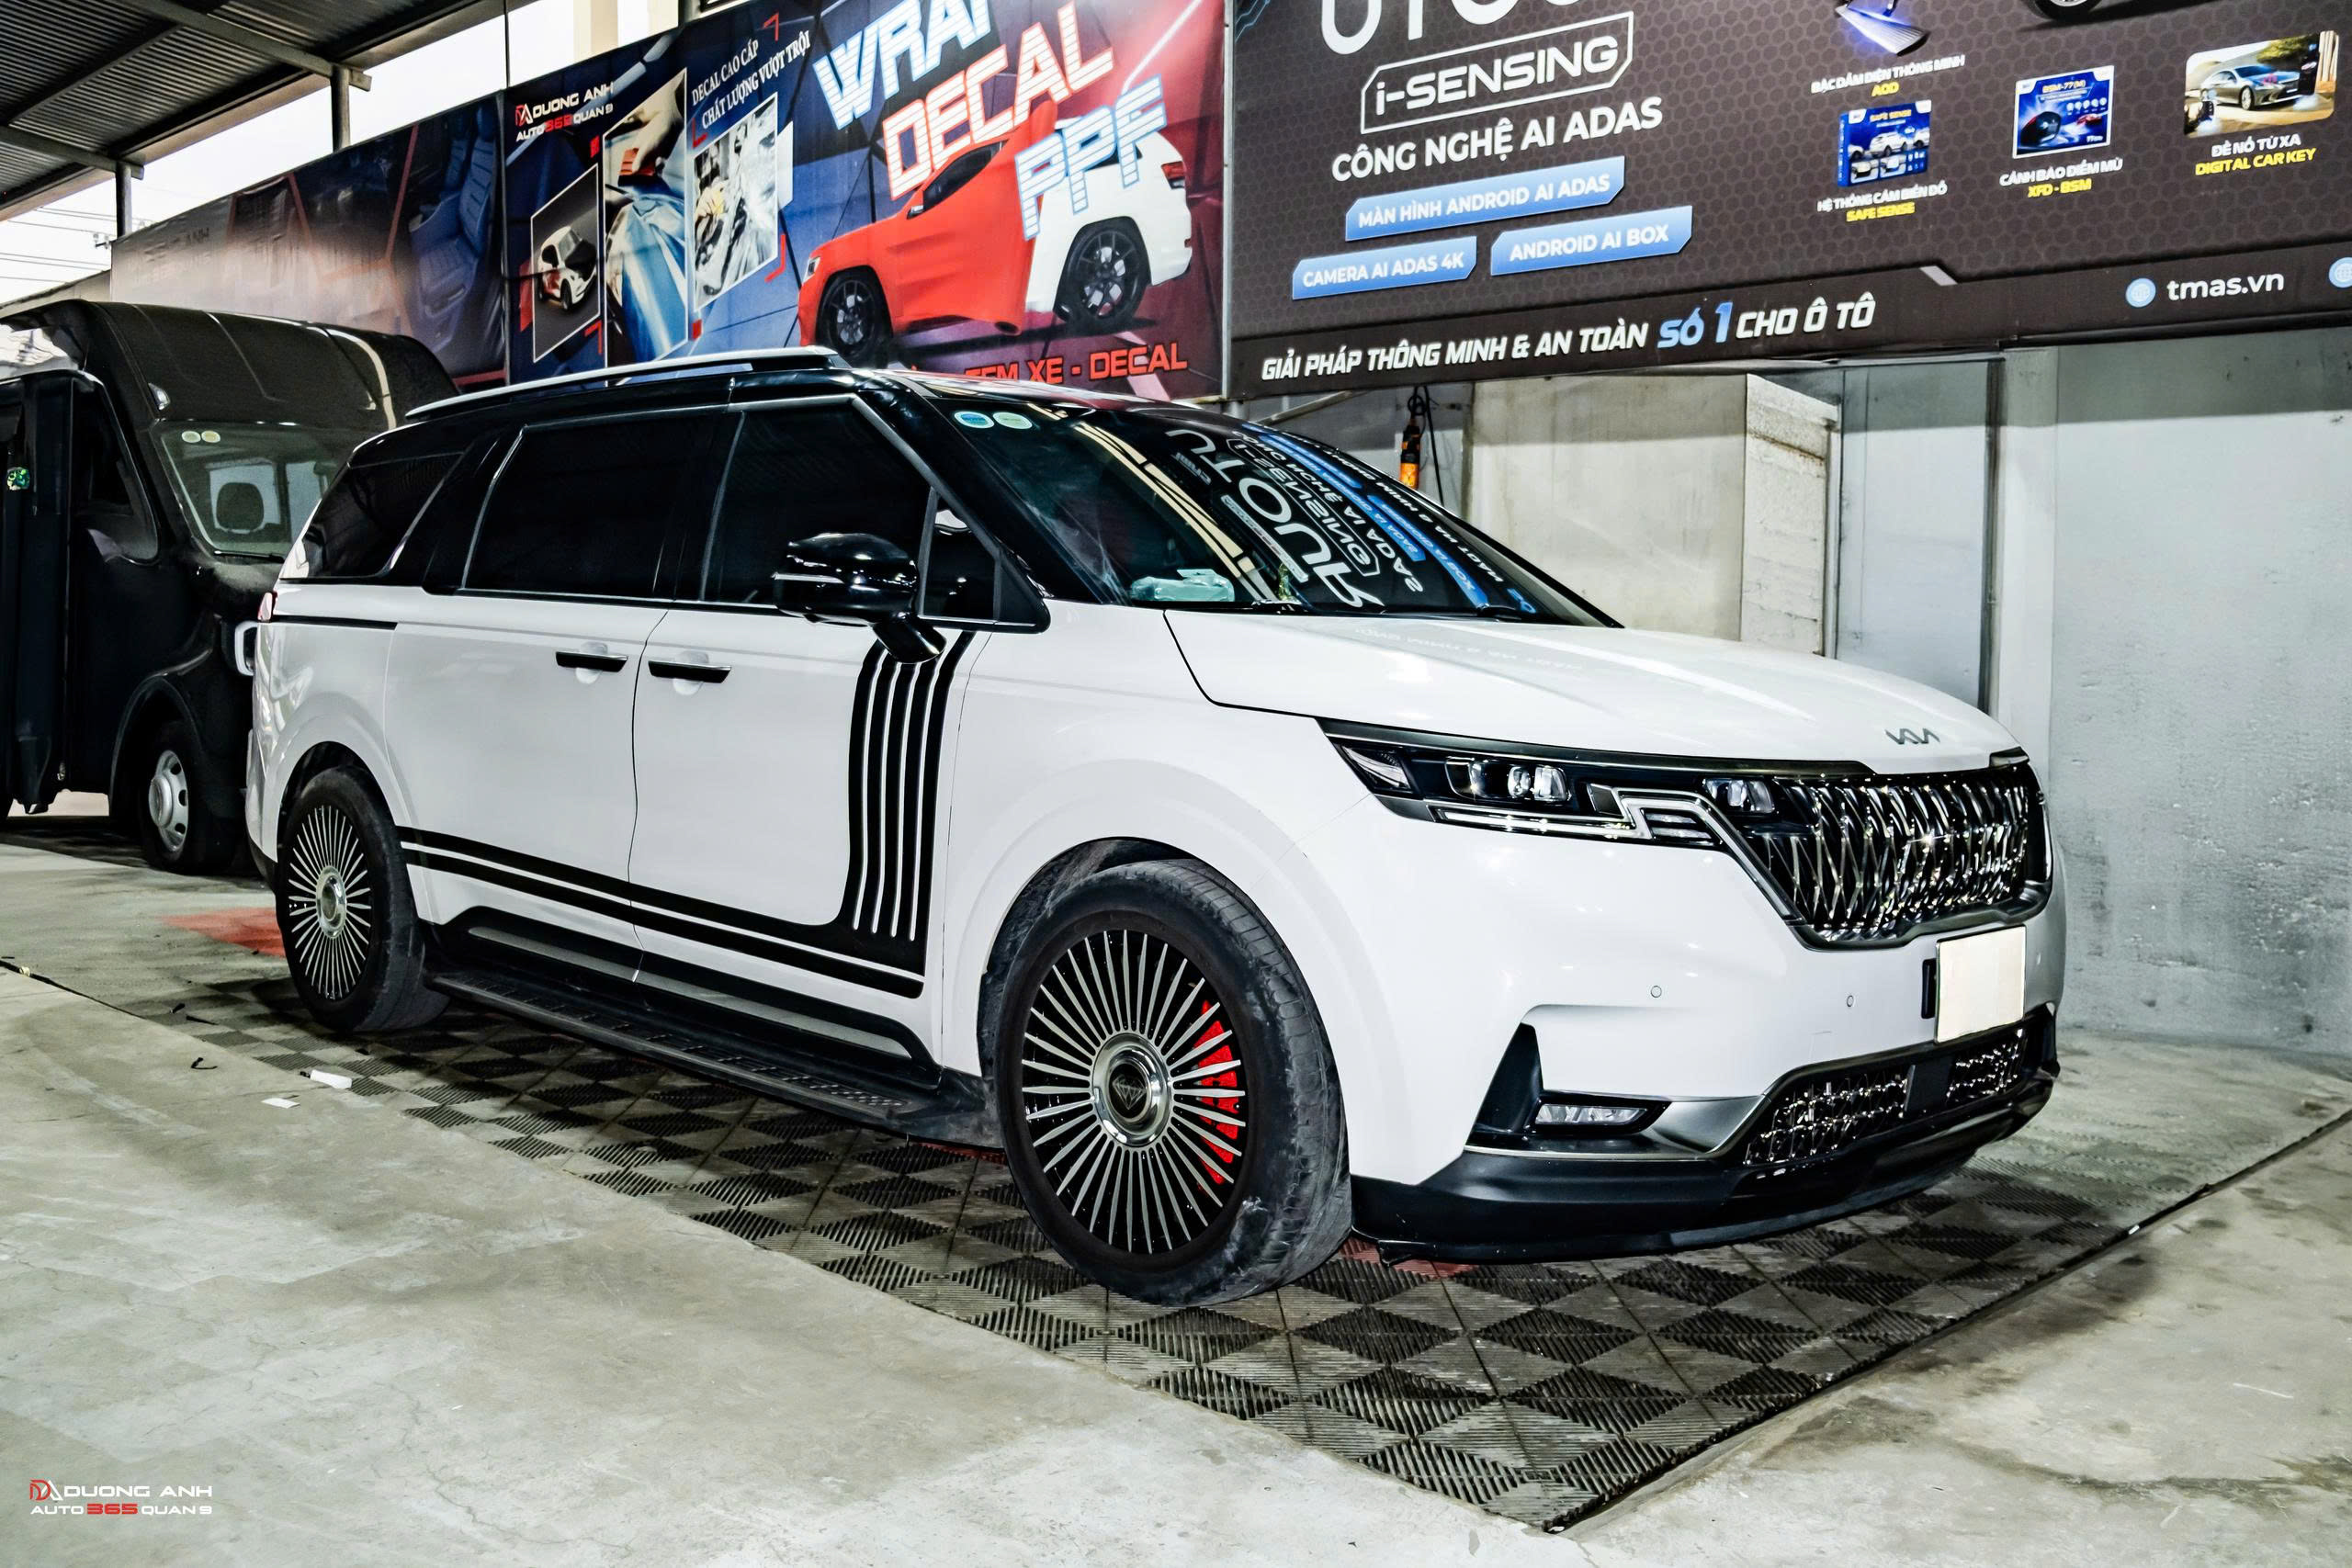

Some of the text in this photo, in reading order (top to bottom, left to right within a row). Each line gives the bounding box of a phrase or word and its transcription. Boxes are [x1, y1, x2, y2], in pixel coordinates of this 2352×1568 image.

[583, 82, 614, 102] ANH
[692, 39, 759, 106] DECAL CAO CẤP
[1376, 35, 1619, 115] i-SENSING
[702, 97, 726, 130] CHẤT
[882, 0, 1114, 200] DECAL
[1015, 73, 1168, 242] PPF
[1331, 96, 1663, 182] CÔNG NGHỆ AI ADAS
[2195, 148, 2317, 175] DIGITAL CAR KEY
[1359, 174, 1610, 229] MÀN HÌNH ANDROID AI ADAS
[1510, 223, 1669, 262] ANDROID AI BOX
[1303, 251, 1464, 288] CAMERA AI ADAS 4K
[2166, 273, 2285, 301] tmas.vn
[1261, 347, 1302, 380] GIẢI
[1304, 344, 1363, 377] PHÁP
[1367, 338, 1442, 371] THÔNG
[1444, 335, 1508, 365] MINH
[1511, 333, 1531, 359] &
[1533, 330, 1573, 357] AN
[1578, 317, 1649, 354] TOÀN
[1714, 301, 1734, 344] 1
[1736, 308, 1799, 339] CHO
[1803, 296, 1828, 333] Ô
[1837, 291, 1876, 329] TÔ
[1027, 356, 1064, 384] XE
[1090, 343, 1187, 379] DECAL
